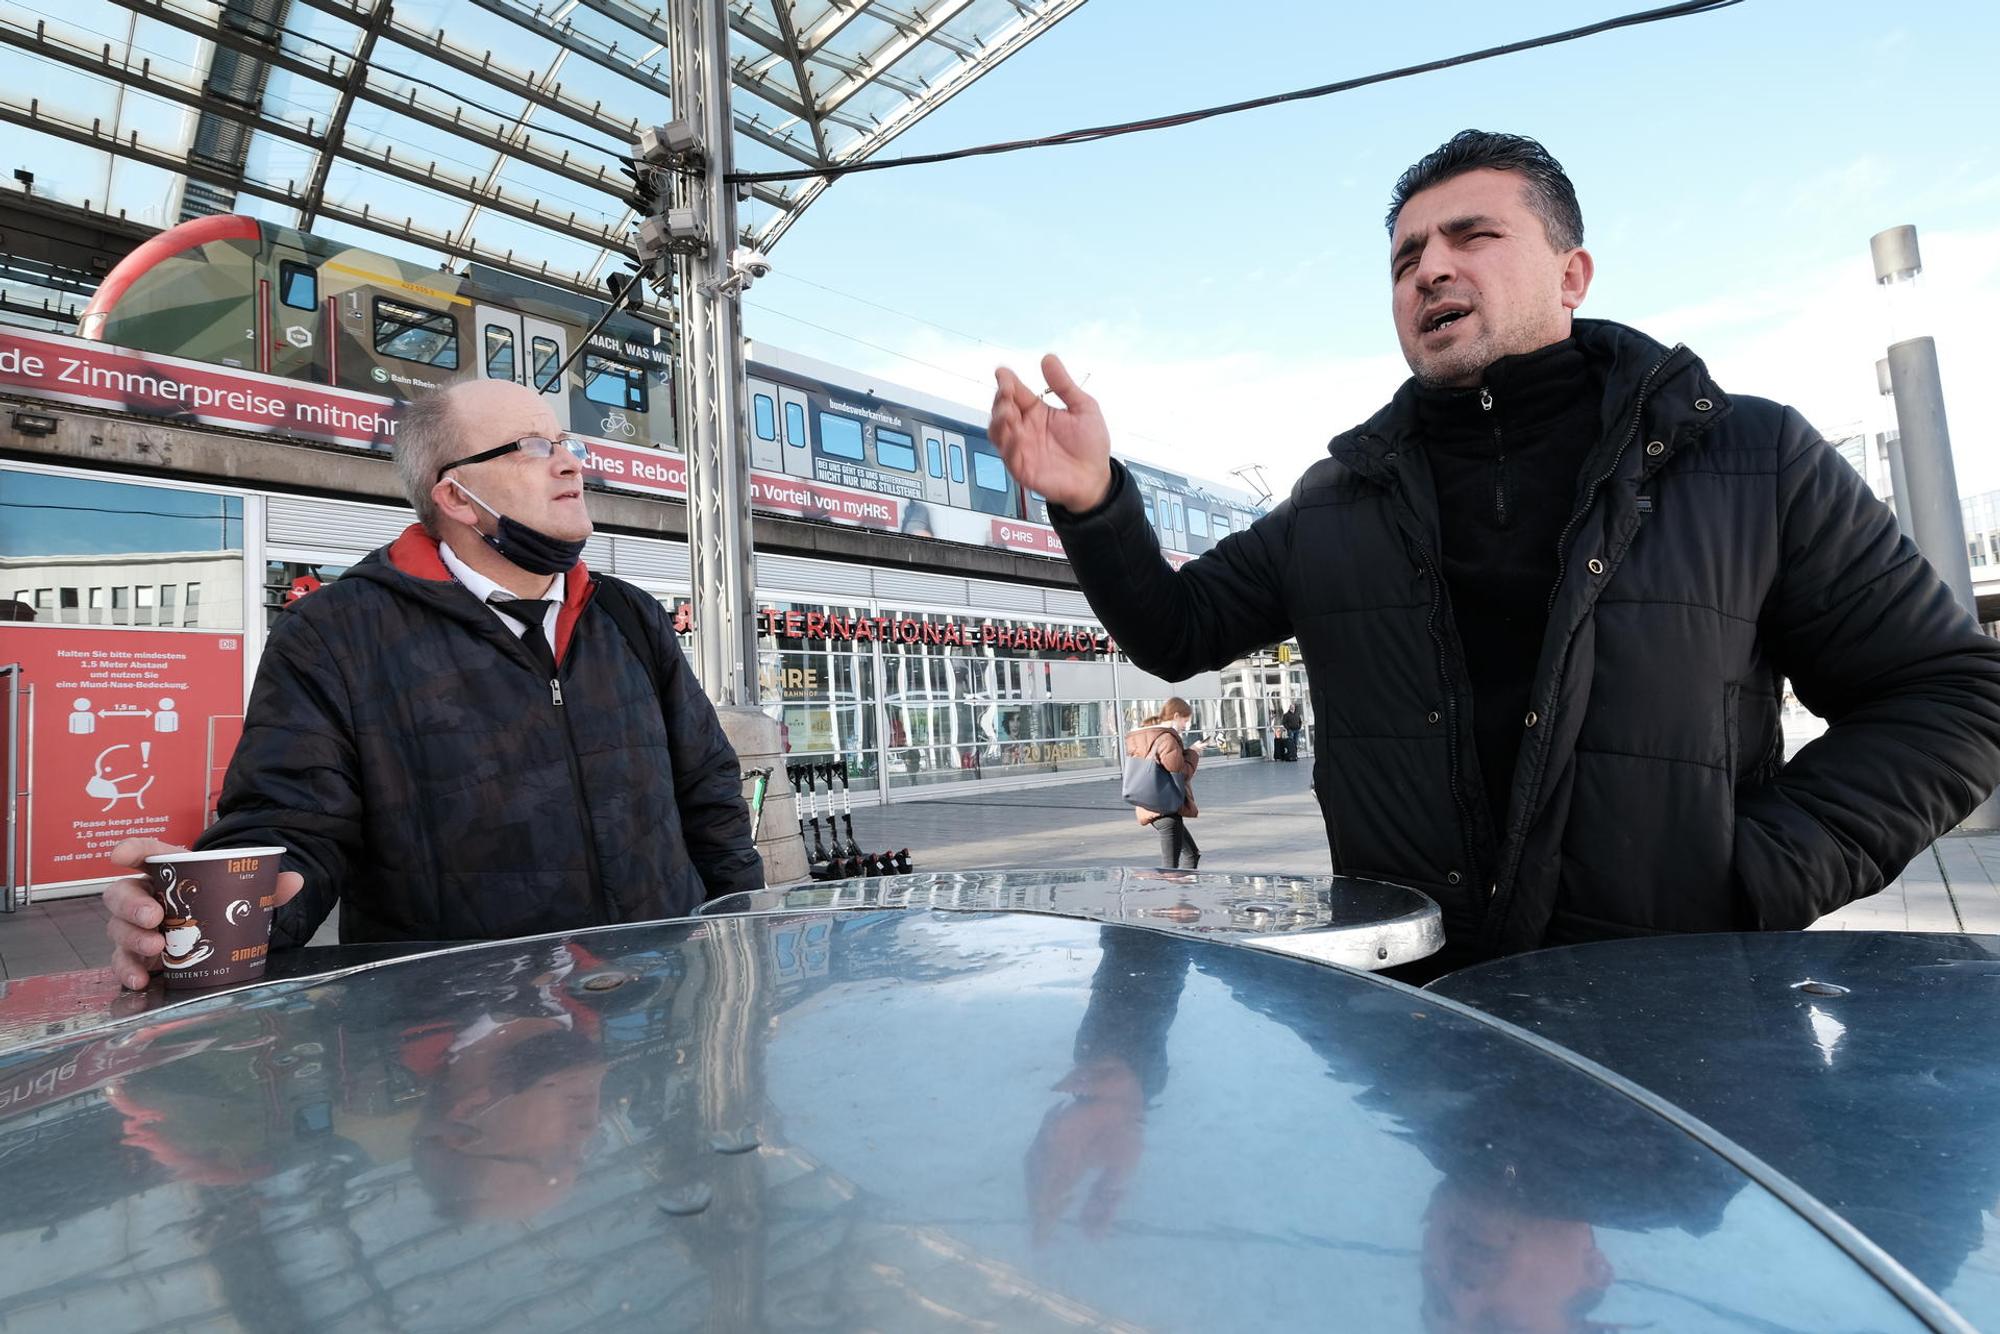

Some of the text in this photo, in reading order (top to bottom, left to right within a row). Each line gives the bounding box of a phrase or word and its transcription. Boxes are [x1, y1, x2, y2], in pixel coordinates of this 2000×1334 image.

[246, 329, 255, 340] 2
[588, 335, 622, 353] MACH,
[625, 343, 650, 359] WAS
[391, 374, 412, 384] Bahn
[659, 371, 670, 386] 2
[0, 348, 44, 377] de
[57, 357, 286, 417] Zimmerpreise
[763, 483, 811, 507] Vorteil
[815, 495, 840, 511] von
[844, 500, 892, 520] myHRS.
[865, 425, 873, 438] 2
[819, 469, 841, 482] NICHT
[843, 474, 859, 487] NUR
[860, 478, 878, 490] UMS
[1012, 531, 1033, 544] HRS
[761, 609, 972, 646] TERNATIONAL
[981, 623, 1098, 652] PHARMACY
[57, 650, 186, 660] Halten Sie bitte mindestens
[99, 661, 128, 669] Meter
[130, 661, 168, 669] Abstand
[760, 668, 817, 689] AHRE
[73, 820, 106, 829] Please
[108, 819, 132, 827] keep
[146, 815, 170, 823] least
[95, 829, 124, 837] meter
[126, 826, 166, 835] distance
[54, 853, 73, 862] and
[75, 852, 93, 860] use
[228, 858, 259, 873] latte
[171, 971, 209, 979] CONTENTS
[213, 967, 231, 976] HOT
